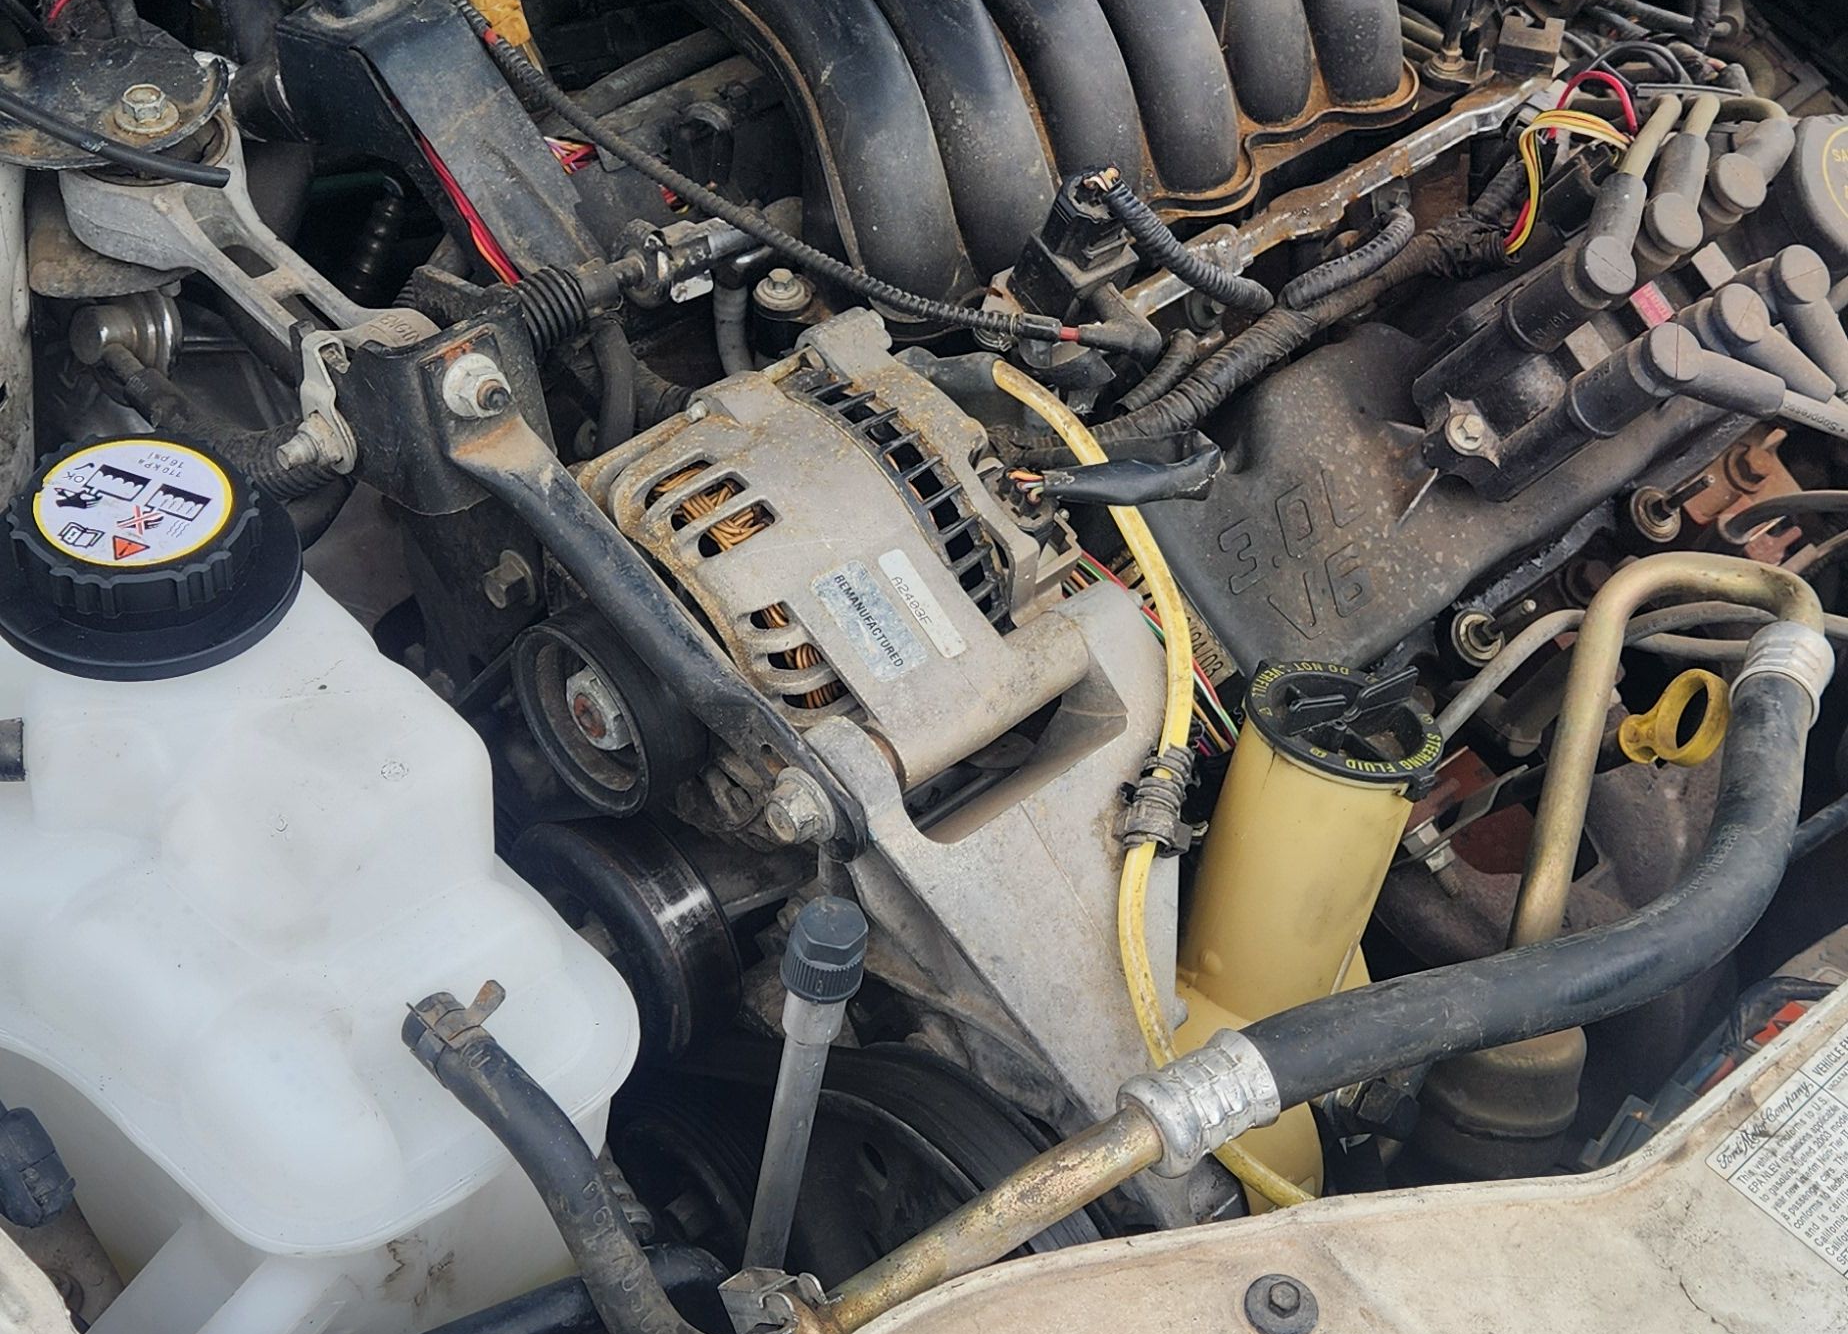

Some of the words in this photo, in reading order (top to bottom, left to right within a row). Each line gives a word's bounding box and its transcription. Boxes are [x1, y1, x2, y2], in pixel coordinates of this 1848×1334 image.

[149, 451, 169, 464] psi
[169, 458, 184, 470] 16
[63, 470, 86, 484] OK
[163, 466, 182, 478] 110
[1217, 469, 1366, 596] 3.0L
[1267, 542, 1373, 640] V6
[832, 573, 905, 669] REMANUFACTURED
[1294, 662, 1323, 672] NOT
[1328, 664, 1352, 676] DO
[1398, 732, 1442, 771] STEERING
[1345, 759, 1397, 774] FLUID
[1812, 1046, 1845, 1076] VEHICLE
[1716, 1144, 1744, 1169] Ford
[1736, 1169, 1756, 1184] This
[1803, 1110, 1815, 1119] to
[1747, 1178, 1765, 1194] EPA
[1760, 1160, 1781, 1181] NLEV
[1758, 1193, 1770, 1203] to
[1768, 1167, 1798, 1196] gasoline
[1812, 1130, 1832, 1149] 2003
[1788, 1181, 1823, 1215] passenger
[1793, 1199, 1823, 1229] conforms
[1819, 1190, 1831, 1201] to
[1804, 1221, 1820, 1238] and
[1817, 1213, 1829, 1223] is
[1825, 1229, 1848, 1256] Califor
